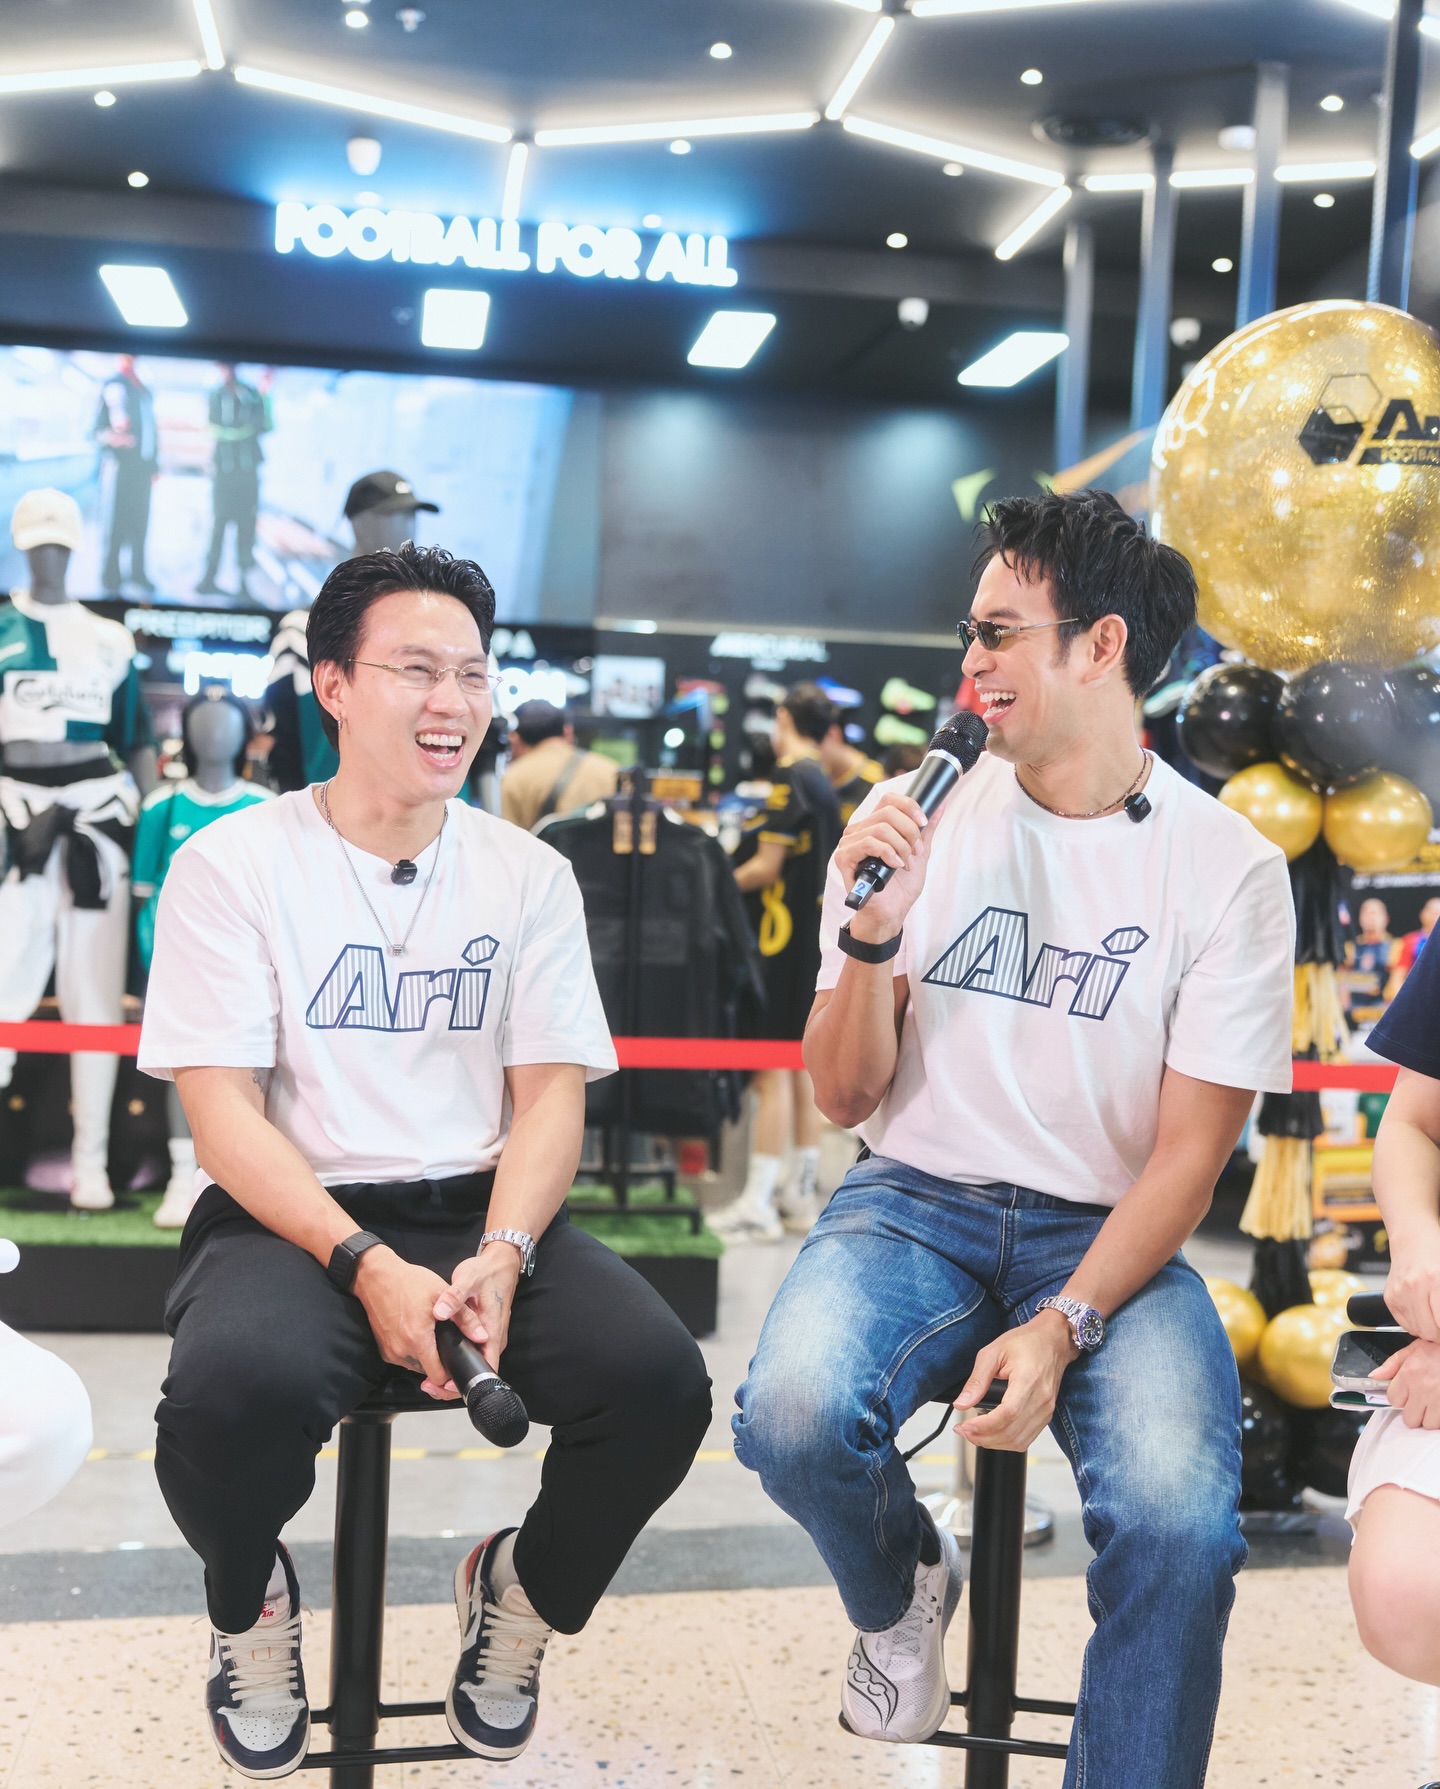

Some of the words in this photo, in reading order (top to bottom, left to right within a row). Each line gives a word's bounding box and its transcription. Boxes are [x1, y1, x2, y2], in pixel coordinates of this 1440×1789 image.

[275, 202, 530, 271] FOOTBALL
[537, 222, 640, 278] FOR
[645, 232, 738, 287] ALL
[758, 877, 794, 958] 8
[855, 882, 866, 895] 2
[305, 933, 501, 1033] Ari
[920, 905, 1150, 1022] Ari
